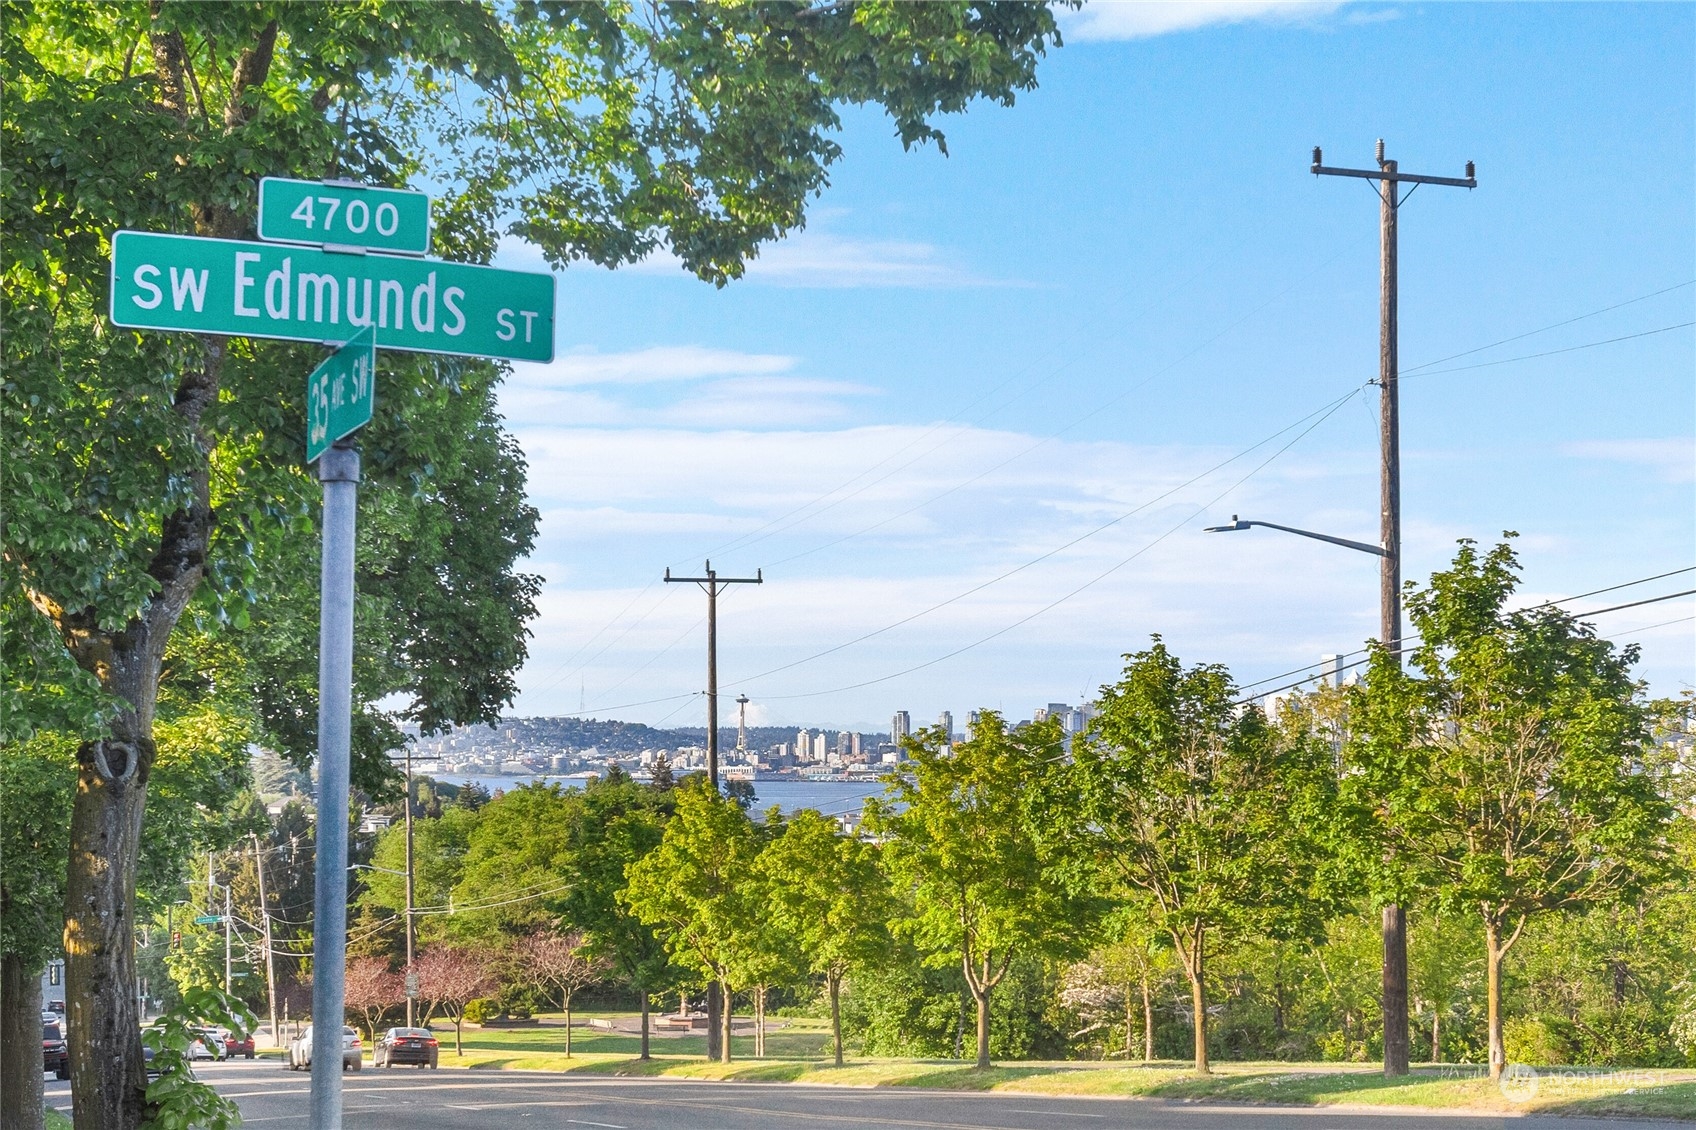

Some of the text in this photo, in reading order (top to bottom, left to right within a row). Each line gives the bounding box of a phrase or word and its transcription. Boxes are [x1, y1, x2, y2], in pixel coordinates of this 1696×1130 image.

[290, 195, 399, 237] 4700
[131, 251, 539, 342] SW Edmunds ST
[310, 372, 329, 446] 35
[351, 351, 369, 405] SW
